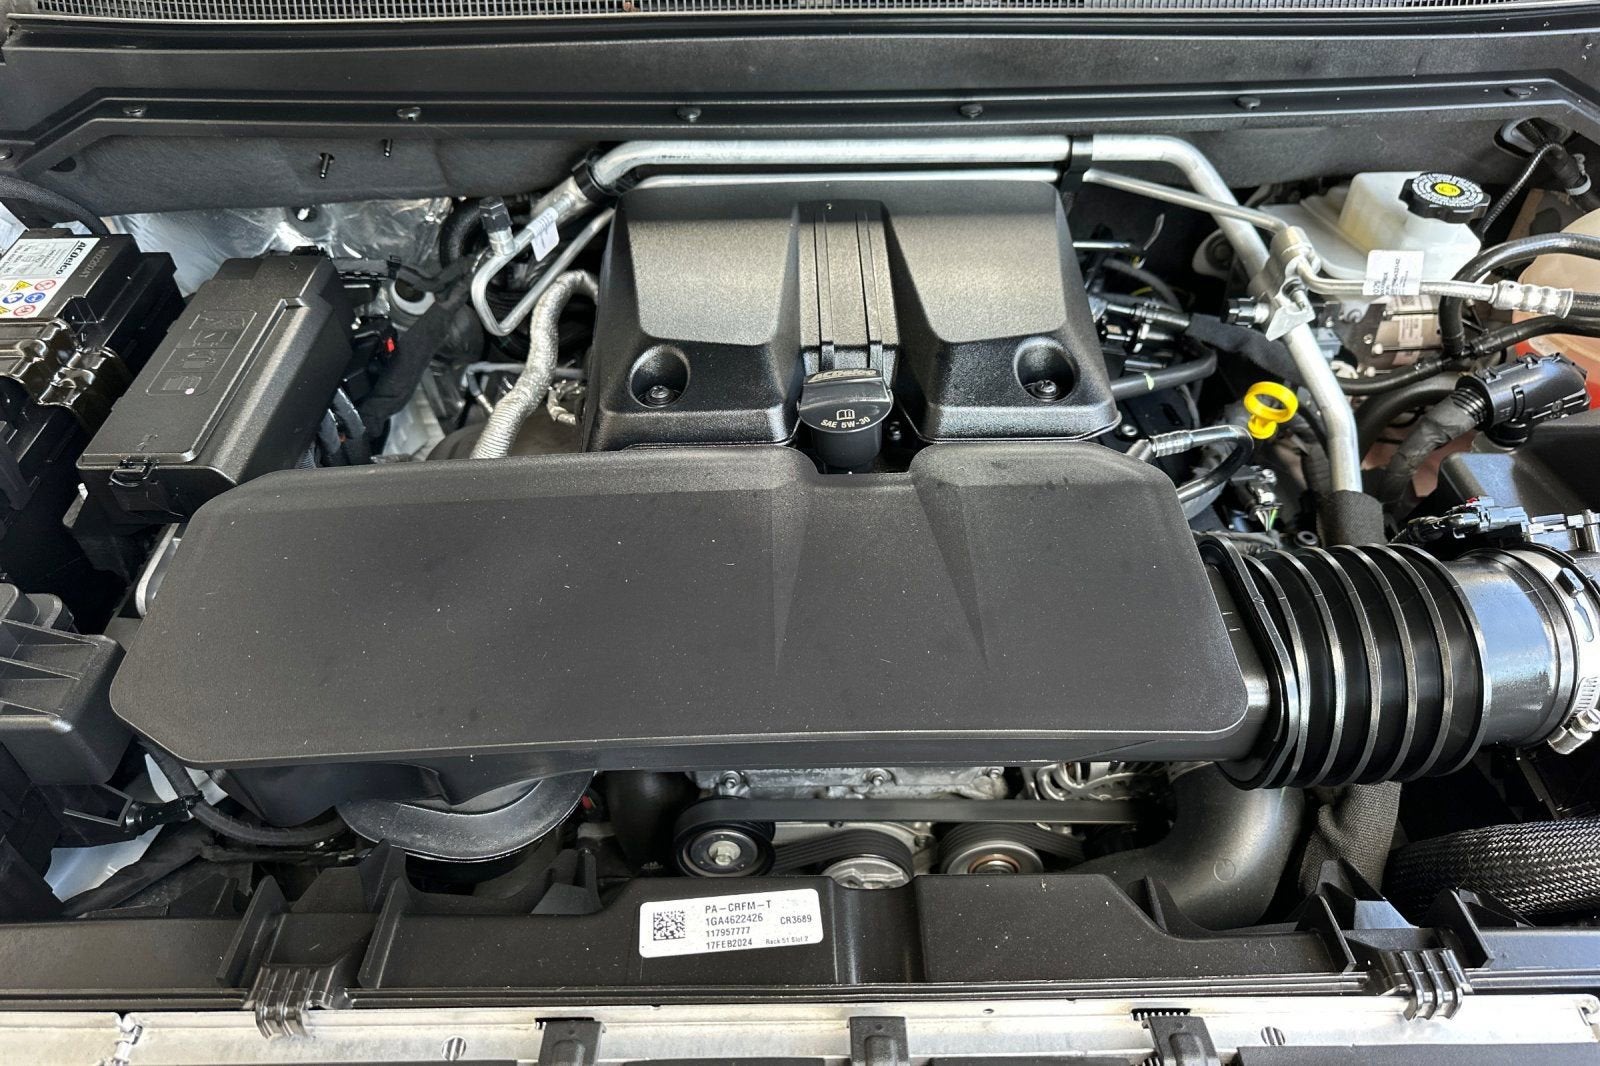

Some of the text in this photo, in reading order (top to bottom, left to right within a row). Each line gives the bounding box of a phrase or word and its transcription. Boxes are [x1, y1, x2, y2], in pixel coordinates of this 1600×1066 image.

[55, 242, 86, 275] ACDelco
[820, 416, 871, 428] SAE 5W-30
[705, 913, 764, 926] 1GA4622426
[780, 914, 812, 926] CR3689
[705, 926, 751, 938] 117957777
[706, 938, 753, 950] 17FEB2024
